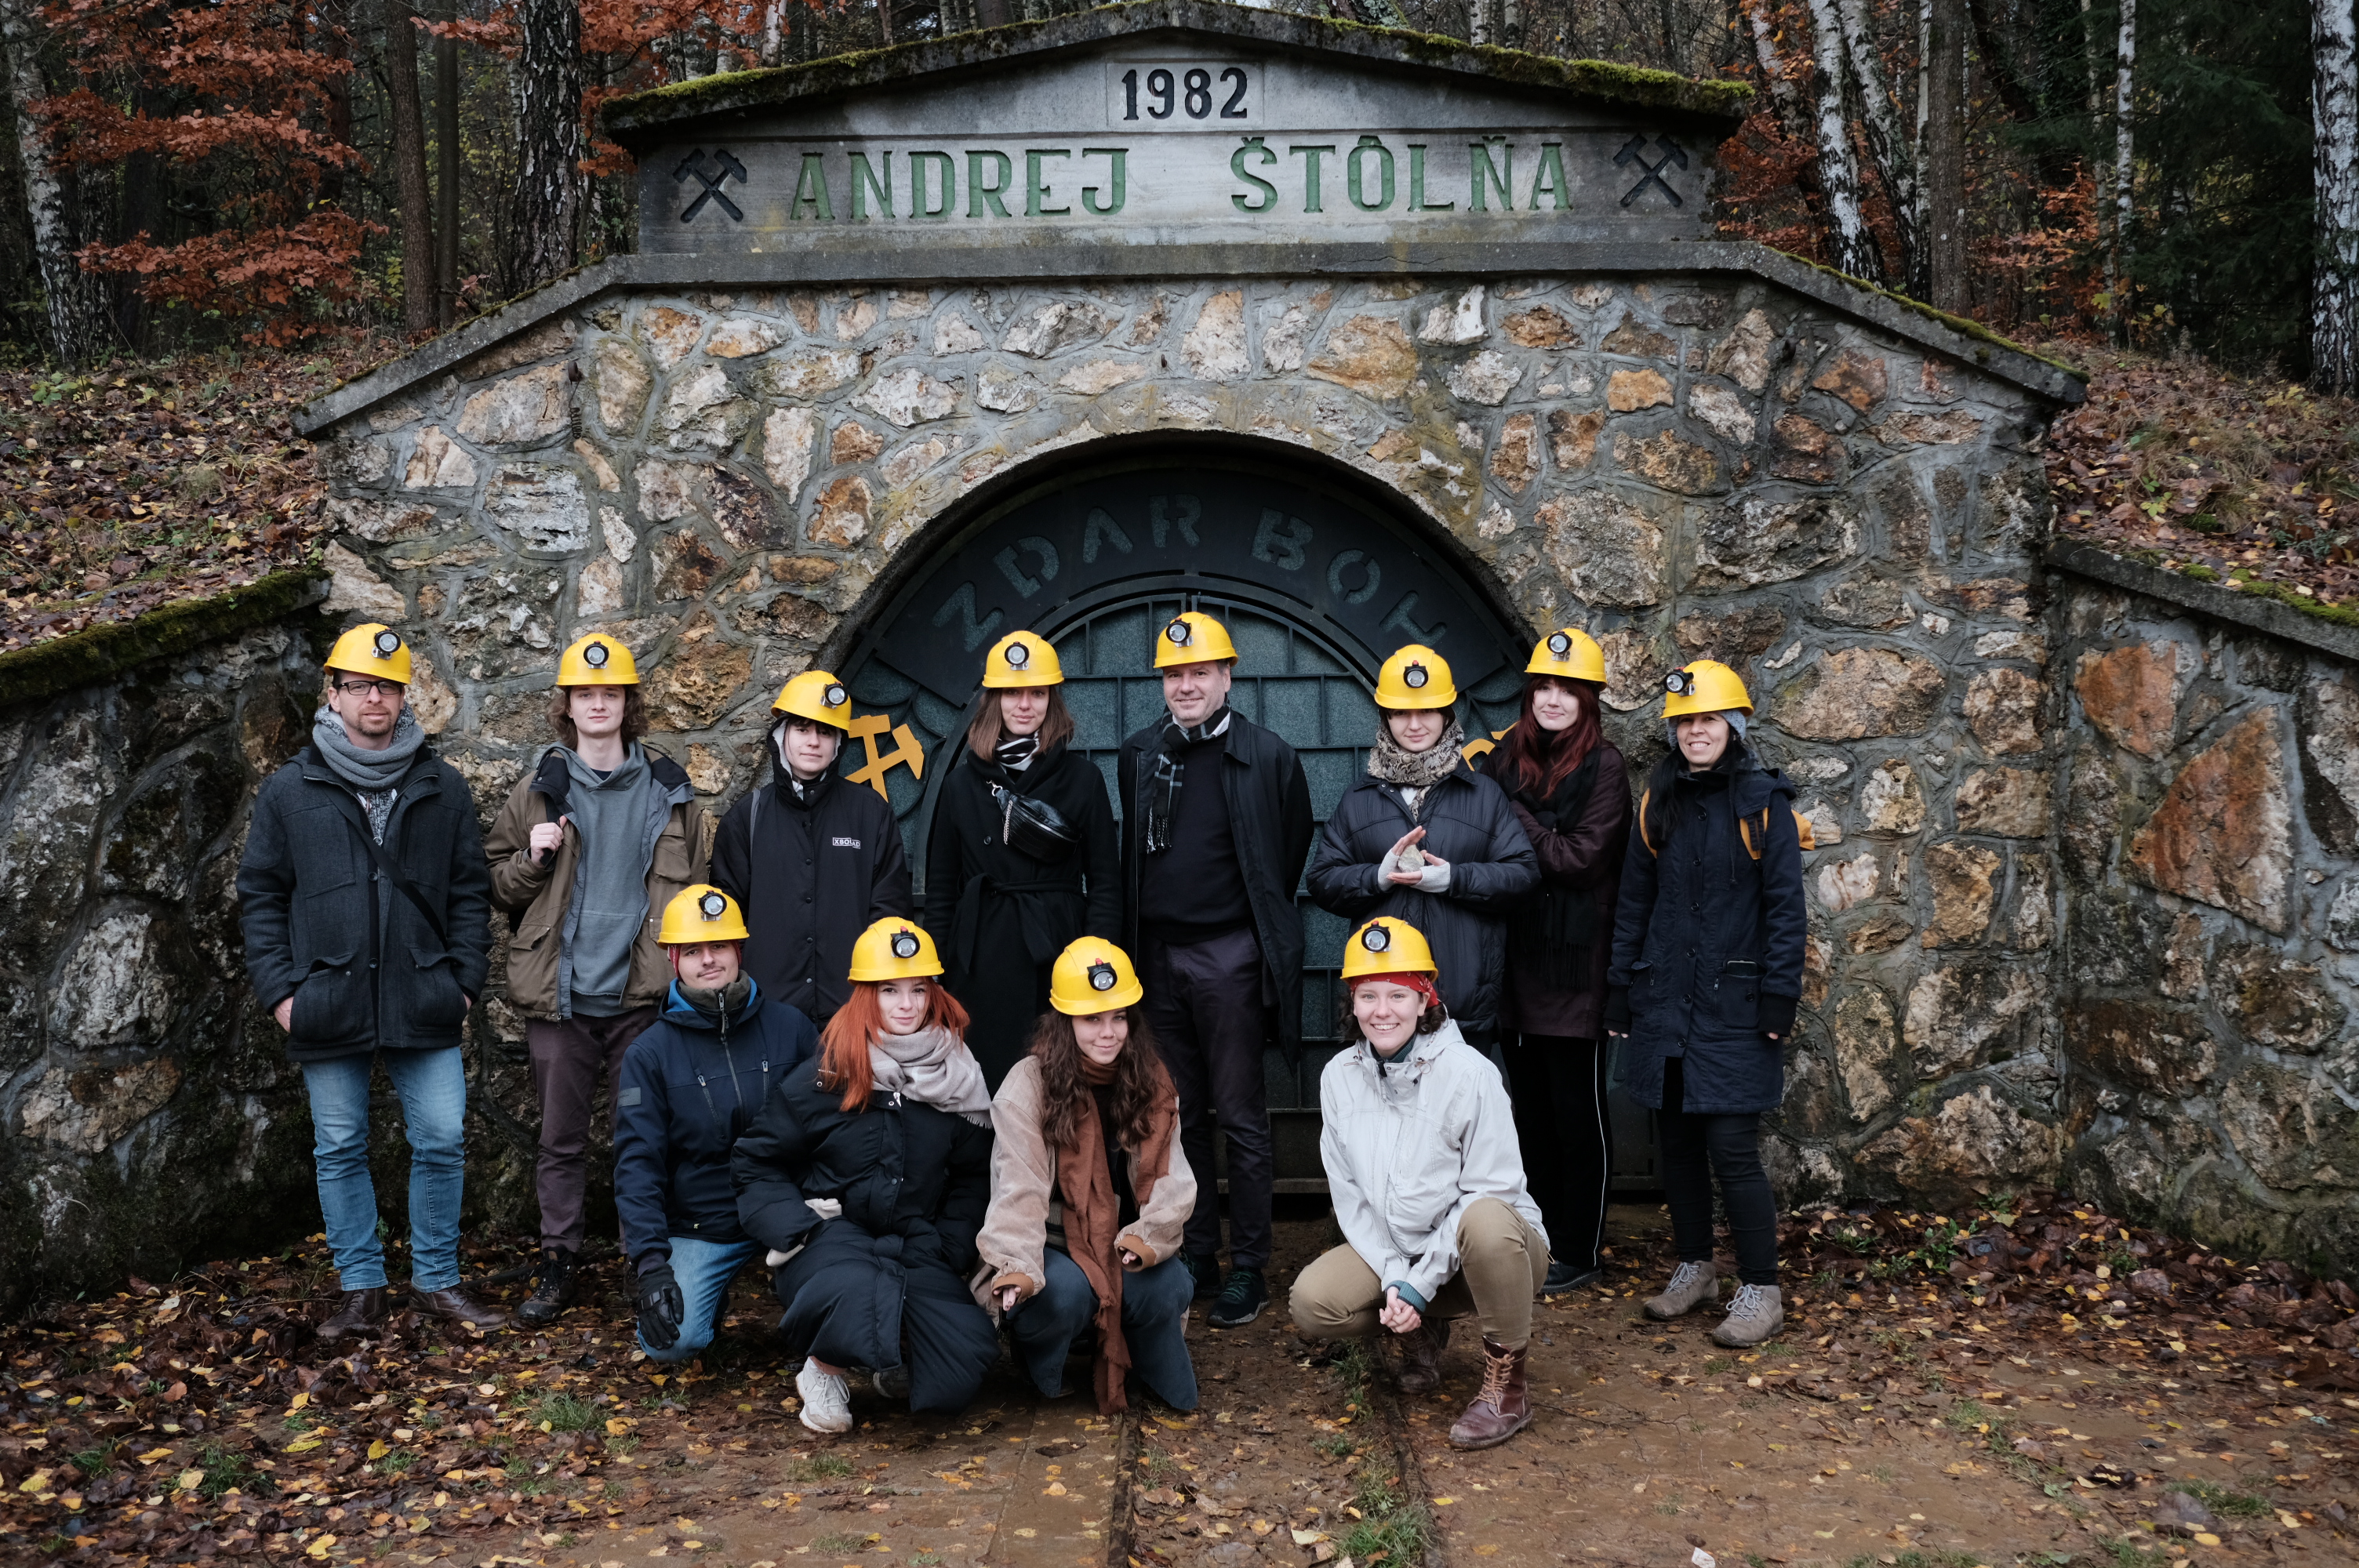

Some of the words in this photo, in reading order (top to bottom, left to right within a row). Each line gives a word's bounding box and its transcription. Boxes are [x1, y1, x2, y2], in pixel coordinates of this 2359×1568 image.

[1121, 67, 1248, 121] 1982
[790, 147, 1129, 221] ANDREJ
[1230, 135, 1573, 214] ŠTÔLŇA
[932, 493, 1202, 653] ZDAR
